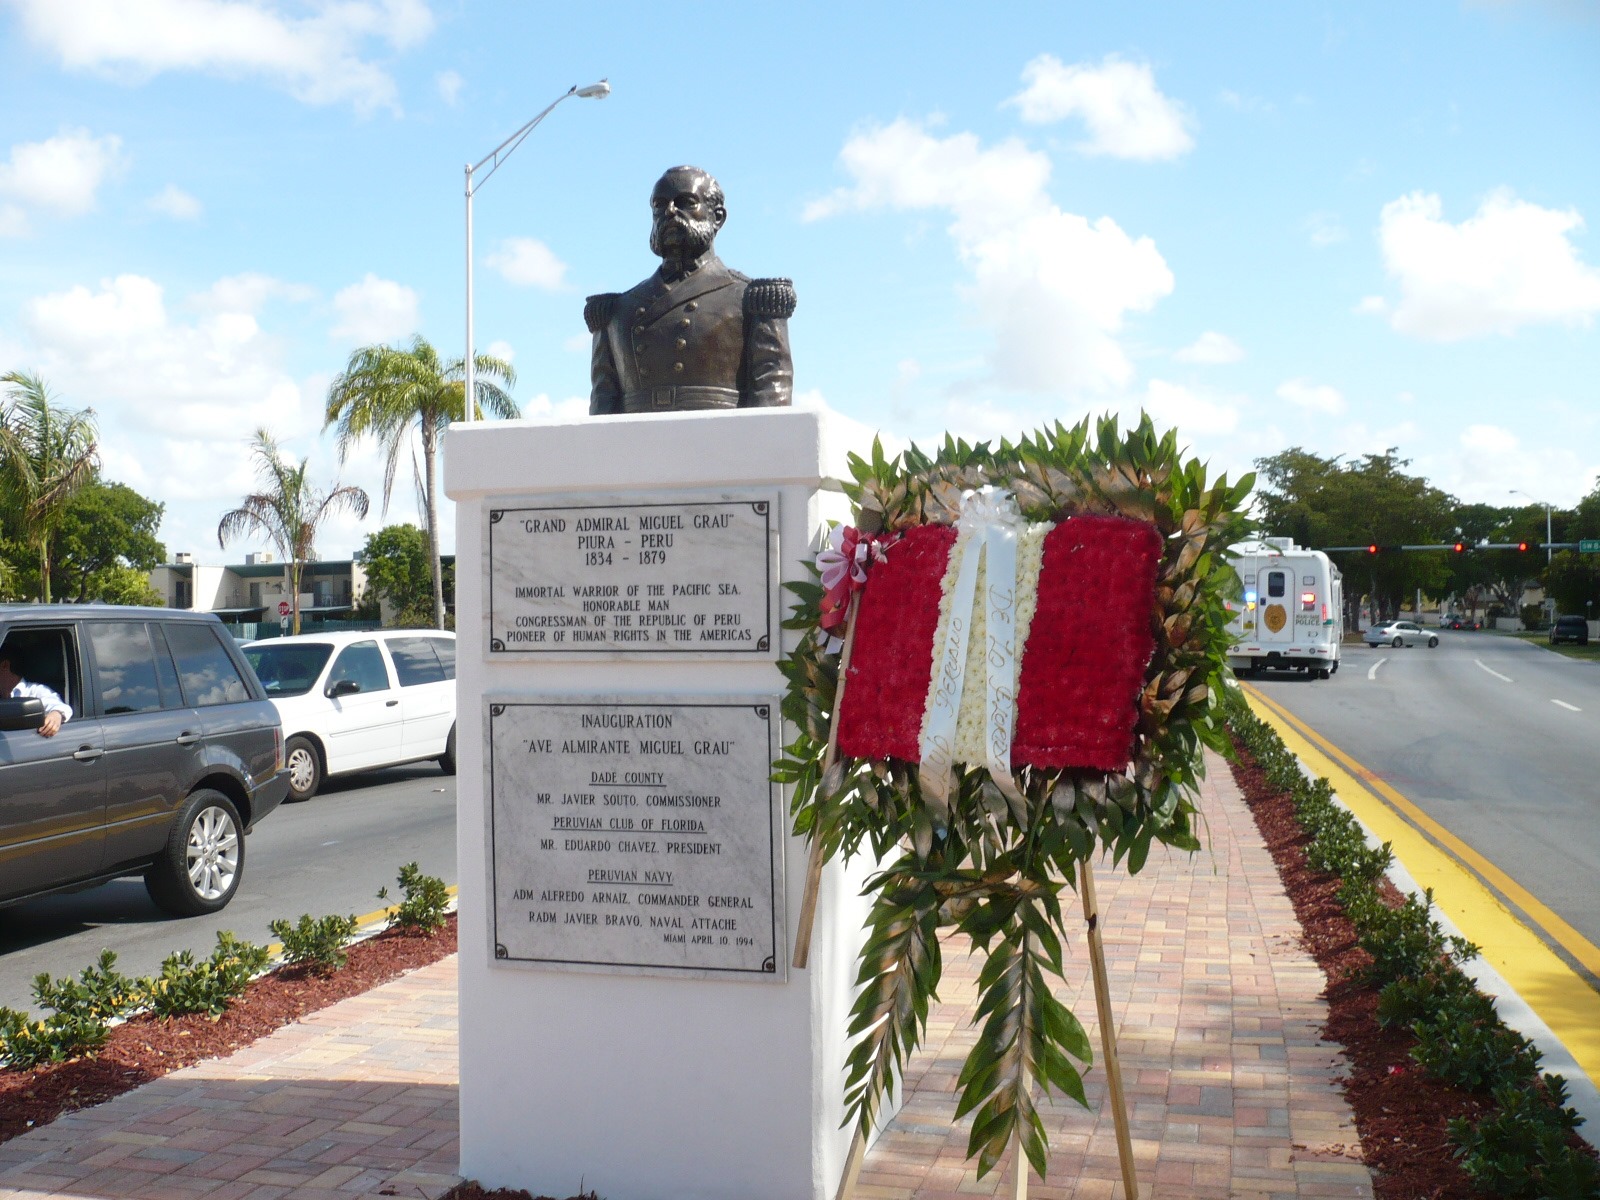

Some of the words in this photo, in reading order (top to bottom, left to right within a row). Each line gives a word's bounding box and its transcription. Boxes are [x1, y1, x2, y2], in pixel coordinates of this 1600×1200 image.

[576, 517, 629, 532] ADMIRAL
[640, 515, 684, 530] MIGUEL
[578, 536, 614, 549] PIURA
[641, 534, 673, 548] PERU
[586, 552, 612, 566] 1834
[640, 550, 666, 564] 1879
[516, 586, 565, 598] IMMORTAL
[573, 586, 619, 597] WARRIOR
[627, 585, 639, 596] OF
[647, 585, 665, 596] THE
[673, 584, 710, 596] PACIFIC
[583, 600, 640, 612] HONORABLE
[649, 600, 669, 611] MAN
[516, 616, 586, 627] CONGRESSMAN
[594, 615, 606, 626] OF
[614, 615, 631, 626] THE
[639, 615, 686, 626] REPUBLIC
[694, 614, 706, 626] OF
[714, 614, 740, 625] PERU
[507, 631, 545, 642] PIONEER
[554, 631, 565, 642] OF
[573, 631, 606, 641] HUMAN
[614, 630, 649, 641] RIGHTS
[657, 630, 666, 641] IN
[674, 630, 692, 641] THE
[700, 629, 751, 641] AMERICAS
[582, 714, 672, 729] INAUGURATION
[562, 740, 630, 754] ALMIRANTE
[640, 741, 684, 755] MIGUEL
[591, 772, 618, 784] DADE
[624, 772, 664, 784] COUNTY
[537, 793, 554, 805] MR.
[562, 794, 595, 805] JAVIER
[646, 795, 721, 807] COMMISSIONER
[553, 817, 602, 829] PERUVIAN
[609, 818, 634, 830] CLUB
[641, 819, 654, 830] OF
[661, 819, 705, 831] FLORIDA
[541, 839, 557, 850] MR.
[565, 840, 611, 851] EDUARDO
[667, 842, 721, 854] PRESIDENT
[588, 869, 638, 881] PERUVIAN
[644, 871, 673, 883] NAVY
[513, 889, 533, 900] ADM
[541, 890, 584, 902] ALFREDO
[638, 894, 699, 906] COMMANDER
[708, 896, 753, 908] GENERAL
[529, 911, 556, 923] RADM
[564, 913, 598, 925] JAVIER
[650, 916, 683, 928] NAVAL
[692, 918, 736, 930] ATTACHE
[664, 934, 685, 943] MIAMI
[692, 935, 713, 944] APRIL
[736, 937, 753, 946] 1994
